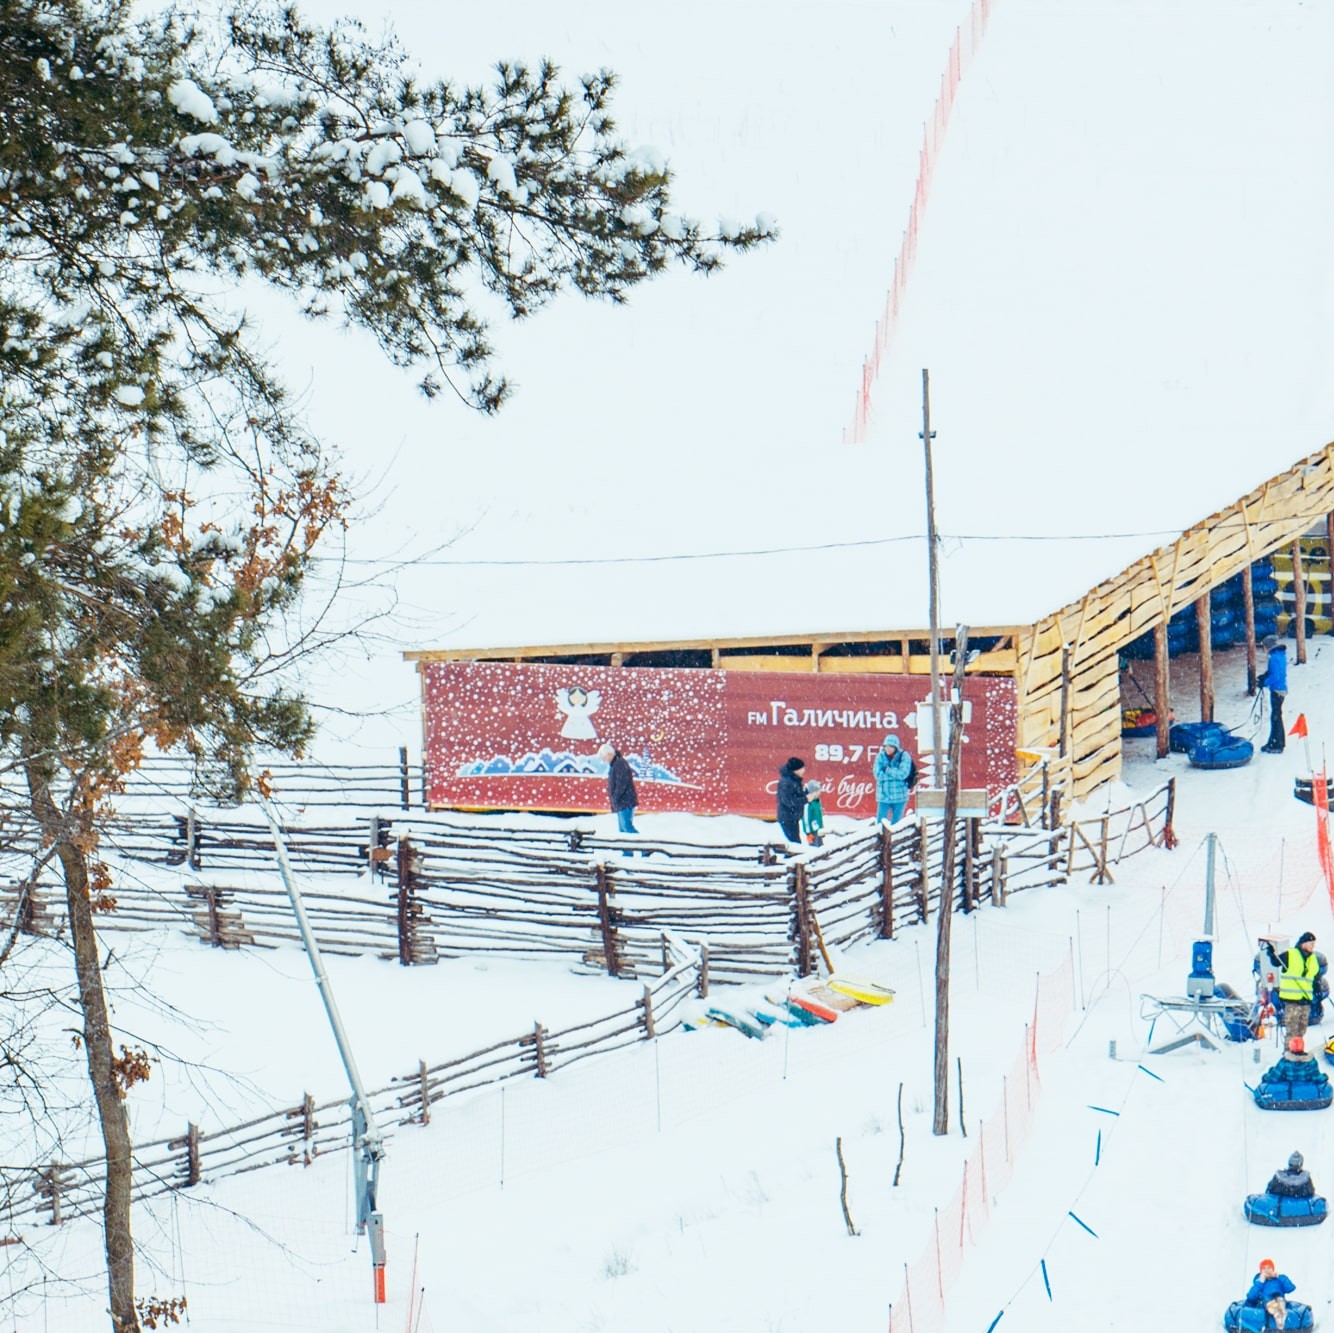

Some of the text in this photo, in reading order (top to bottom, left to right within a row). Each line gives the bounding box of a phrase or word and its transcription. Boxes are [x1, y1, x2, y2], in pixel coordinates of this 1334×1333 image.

[748, 700, 899, 729] FM Галичина
[815, 743, 864, 765] 89,7
